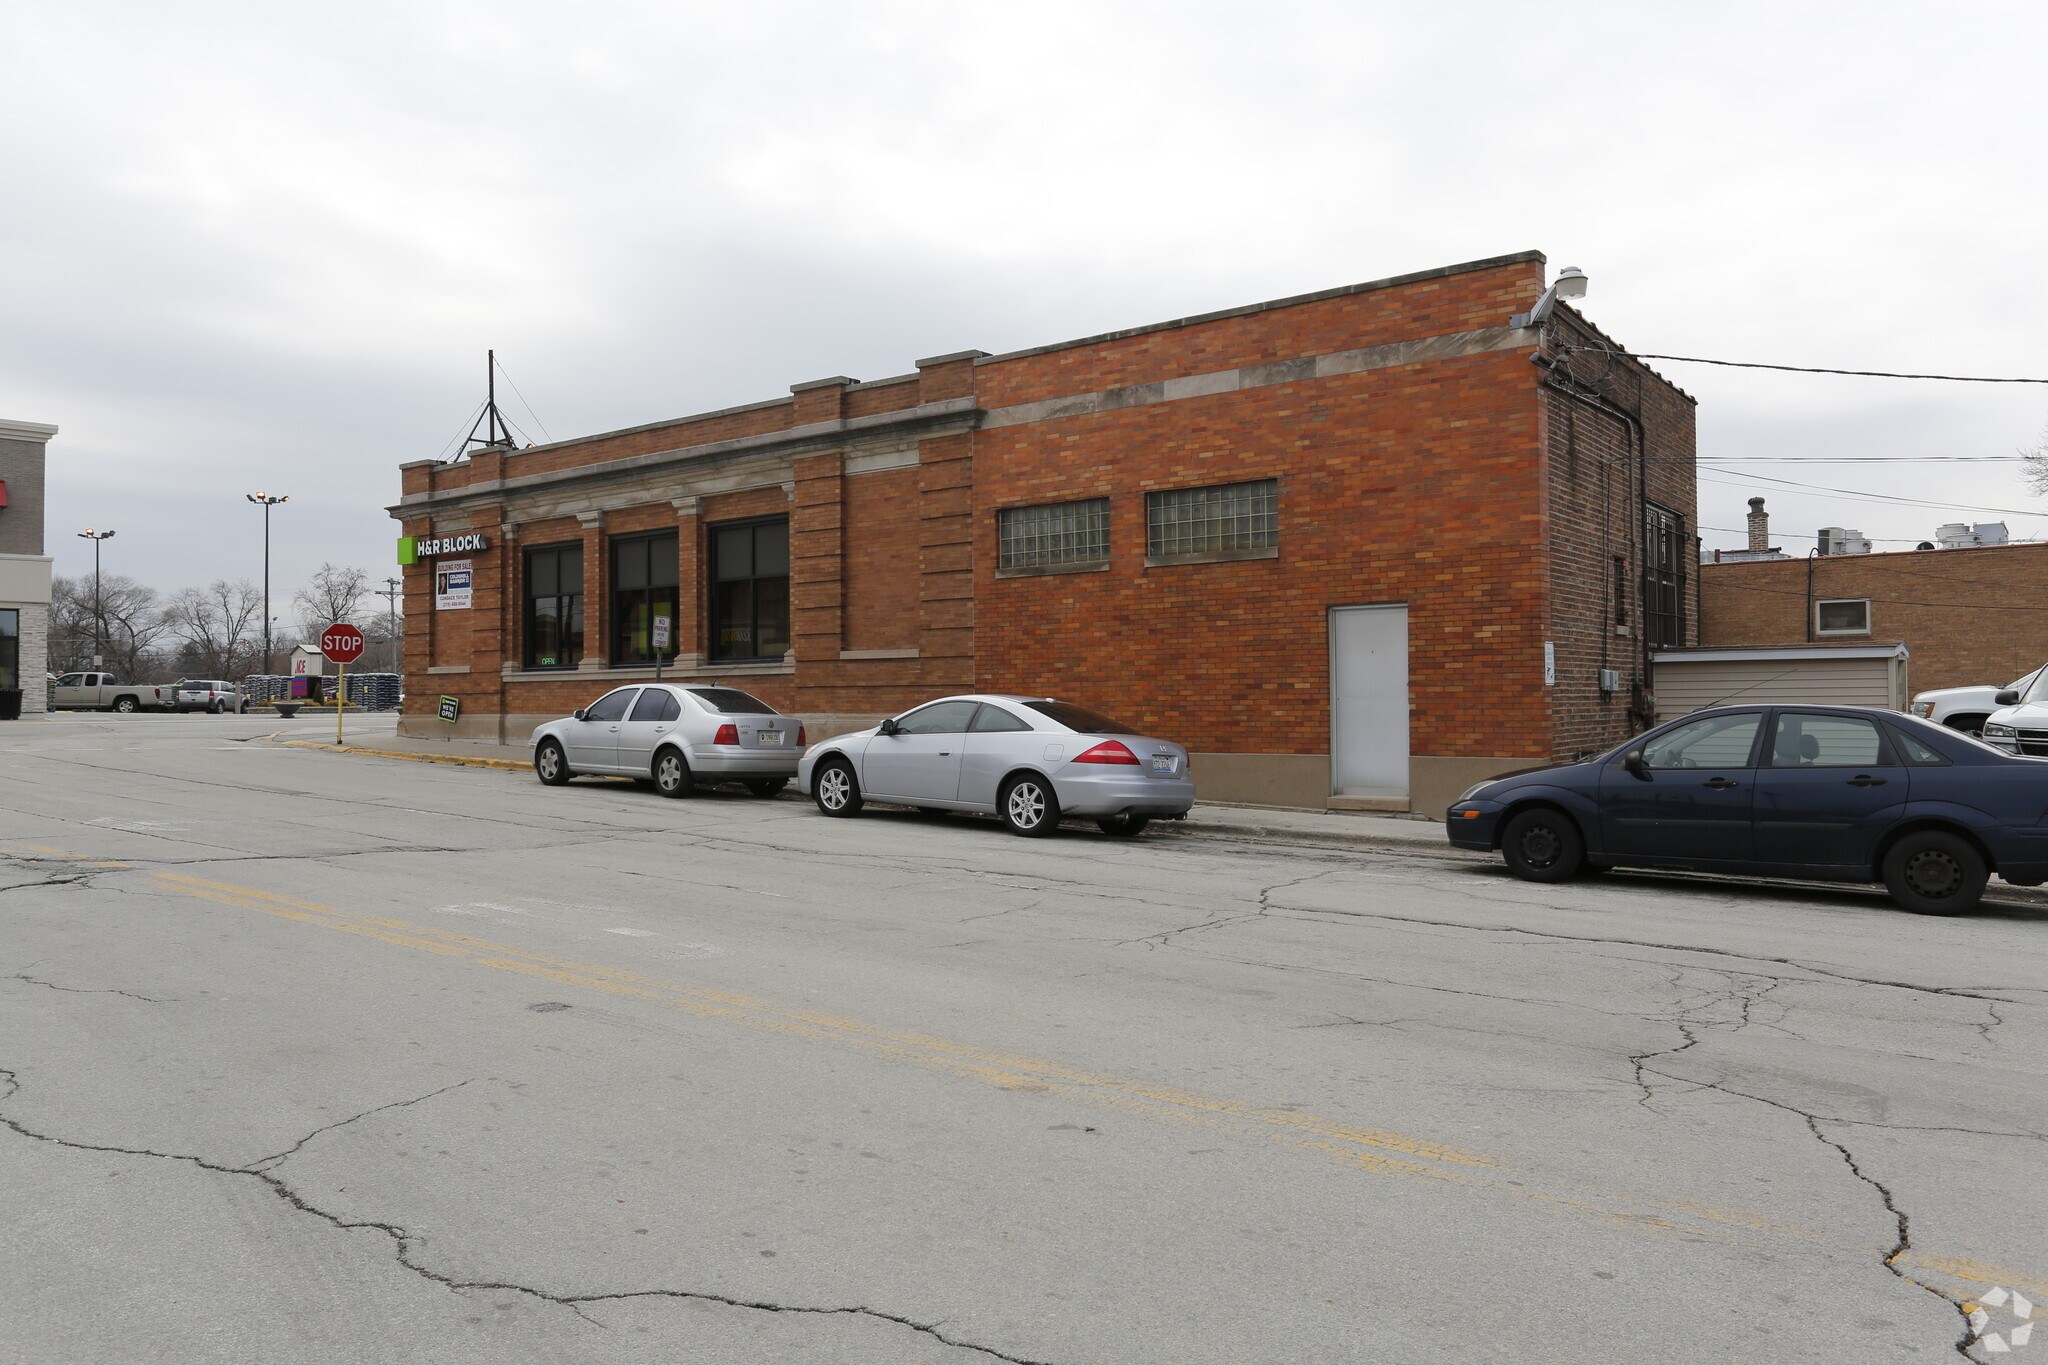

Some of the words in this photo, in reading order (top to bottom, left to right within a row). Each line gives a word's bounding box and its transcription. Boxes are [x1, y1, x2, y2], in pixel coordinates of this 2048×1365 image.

[417, 539, 441, 557] H&R
[443, 534, 481, 553] BLOCK
[438, 564, 454, 572] BUILDING
[454, 563, 462, 571] FOR
[462, 562, 471, 570] SALE
[323, 635, 362, 651] STOP
[541, 657, 555, 665] OPEN
[442, 710, 453, 718] OPEN
